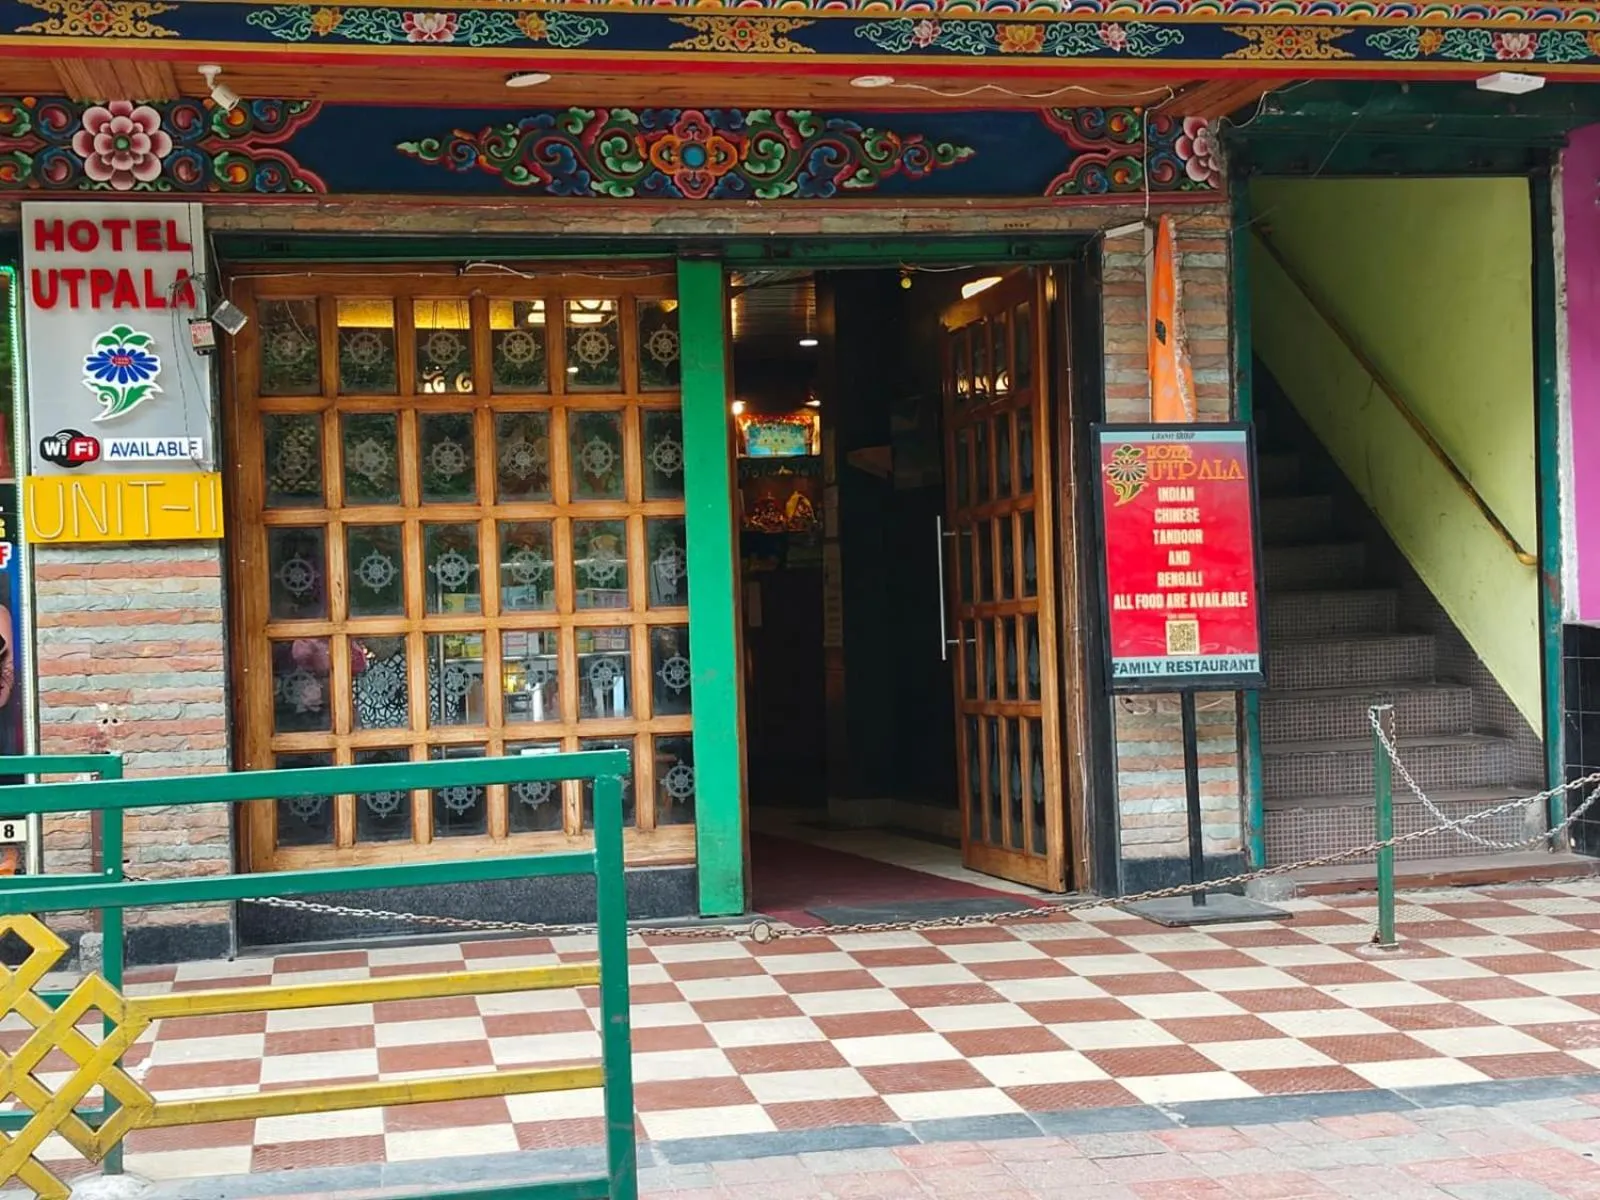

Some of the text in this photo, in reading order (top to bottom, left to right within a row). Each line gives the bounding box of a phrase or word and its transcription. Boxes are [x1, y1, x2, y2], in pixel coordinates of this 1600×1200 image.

[34, 219, 193, 252] HOTEL
[31, 268, 196, 310] UTPALA
[1149, 459, 1245, 480] UTPALA
[1158, 487, 1195, 502] INDIAN
[29, 480, 217, 539] UNIT-II
[1154, 508, 1200, 523] CHINESE
[1152, 529, 1204, 545] TANDOOR
[1168, 550, 1191, 566] AND
[1157, 571, 1203, 587] BENGALI
[1113, 591, 1249, 610] ALL FOOD ARE AVAILABLE
[1113, 659, 1256, 675] FAMILY RESTAURANT
